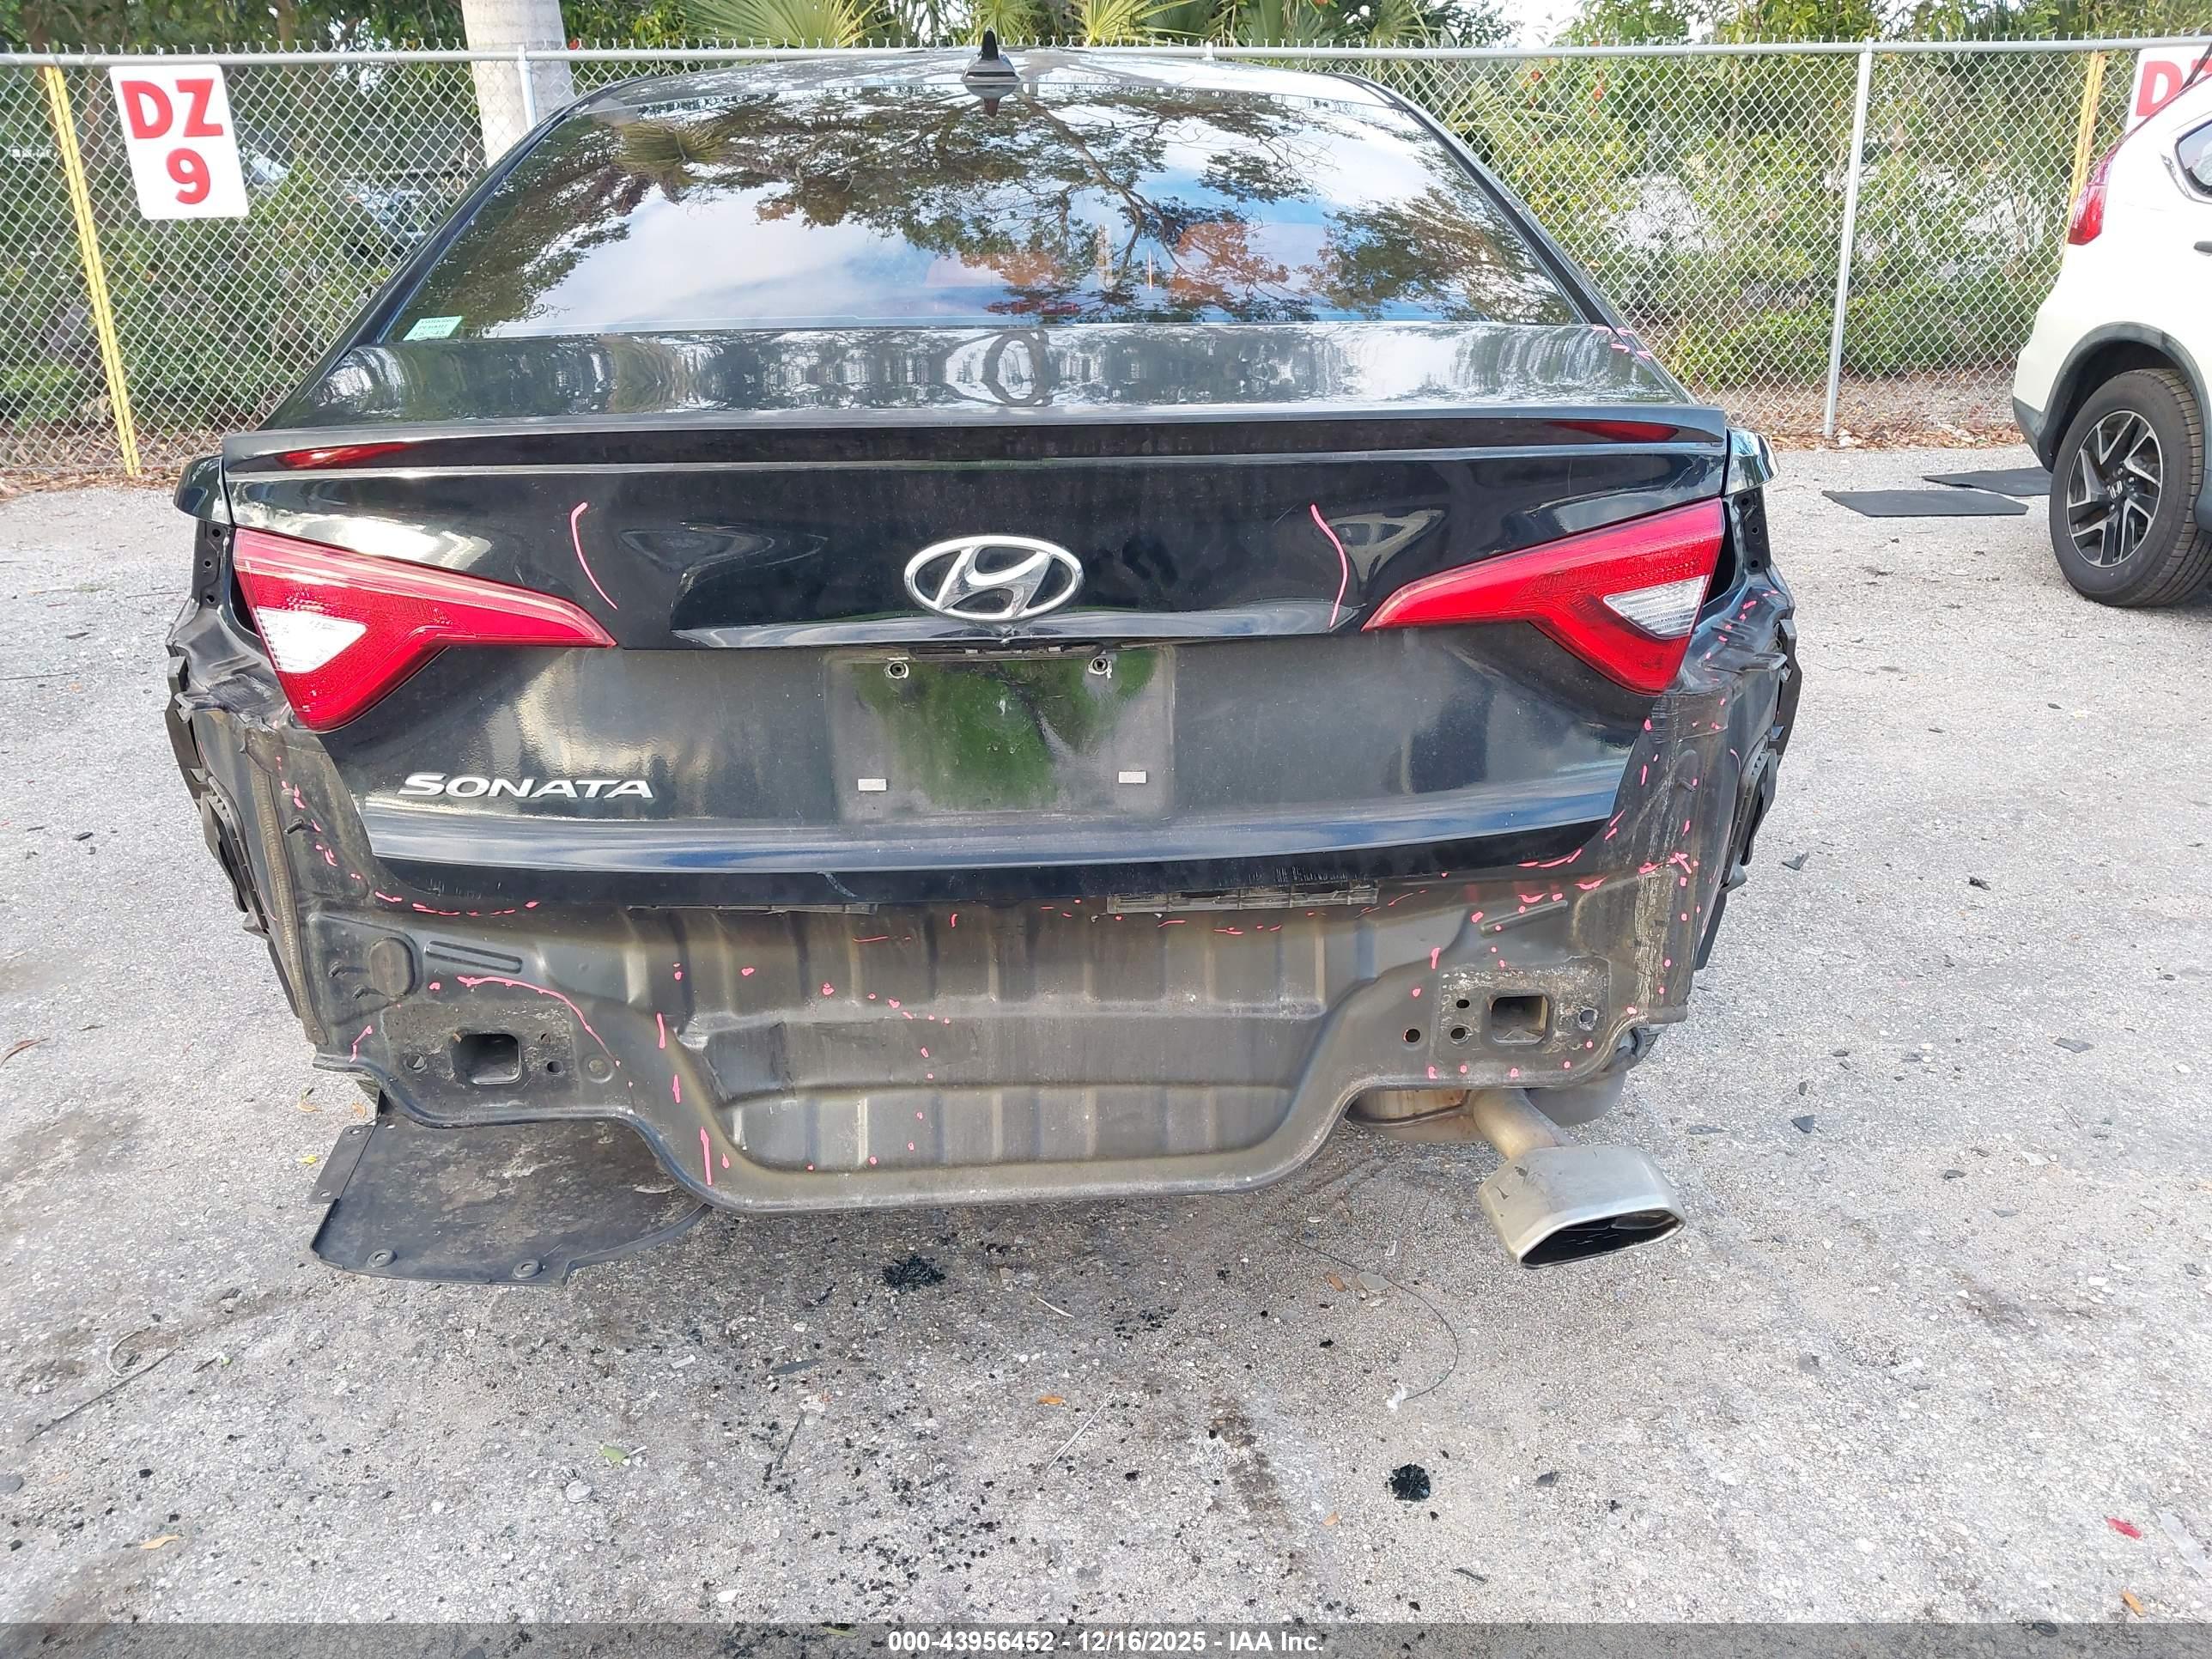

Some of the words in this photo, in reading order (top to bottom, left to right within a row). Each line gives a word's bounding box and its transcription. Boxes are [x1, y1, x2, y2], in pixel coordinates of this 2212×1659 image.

[120, 78, 224, 139] DZ
[2136, 60, 2212, 117] D
[166, 148, 211, 204] 9
[398, 773, 653, 799] SONATA
